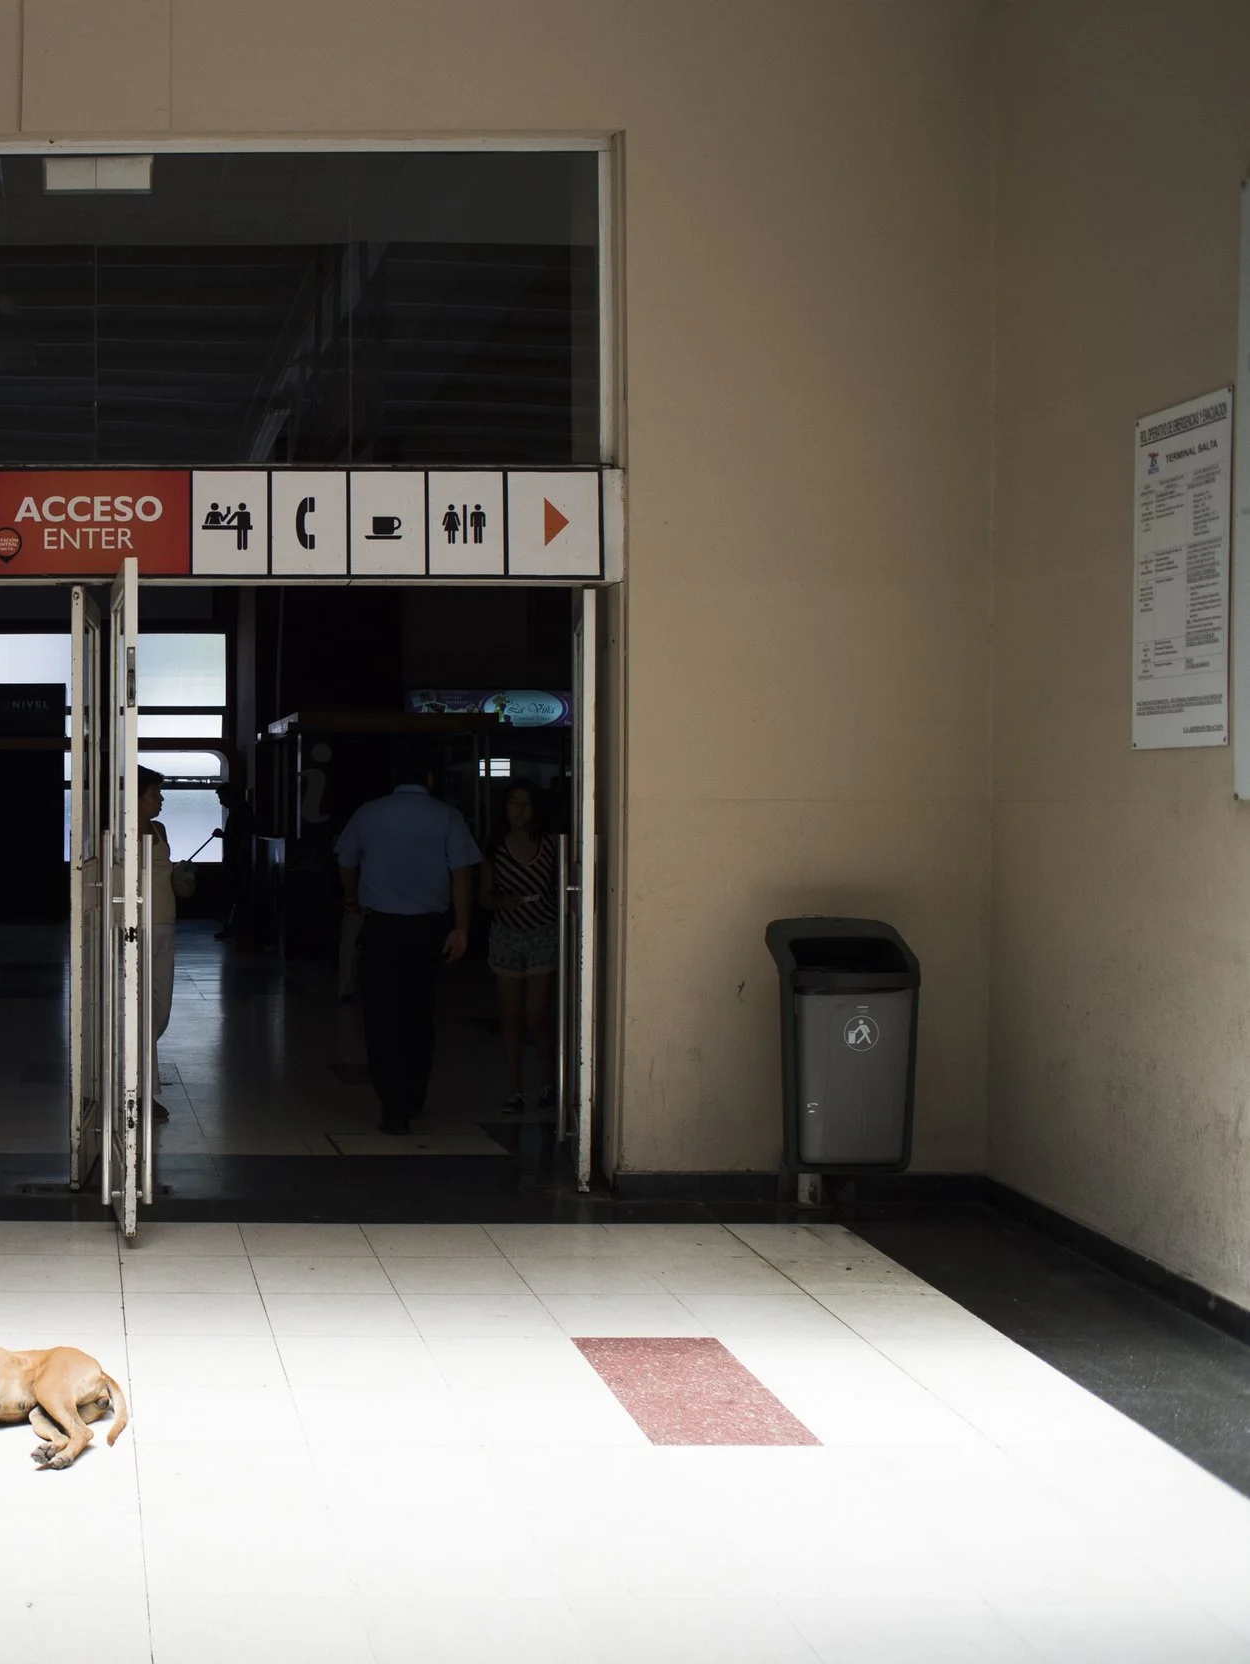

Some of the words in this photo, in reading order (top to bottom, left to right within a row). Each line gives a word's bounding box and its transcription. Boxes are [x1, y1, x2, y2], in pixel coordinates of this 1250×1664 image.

[1166, 446, 1196, 463] TERMINAL
[1198, 439, 1218, 453] SALTA
[14, 495, 163, 522] ACCESO
[44, 528, 134, 549] ENTER
[12, 700, 51, 709] NIVEL
